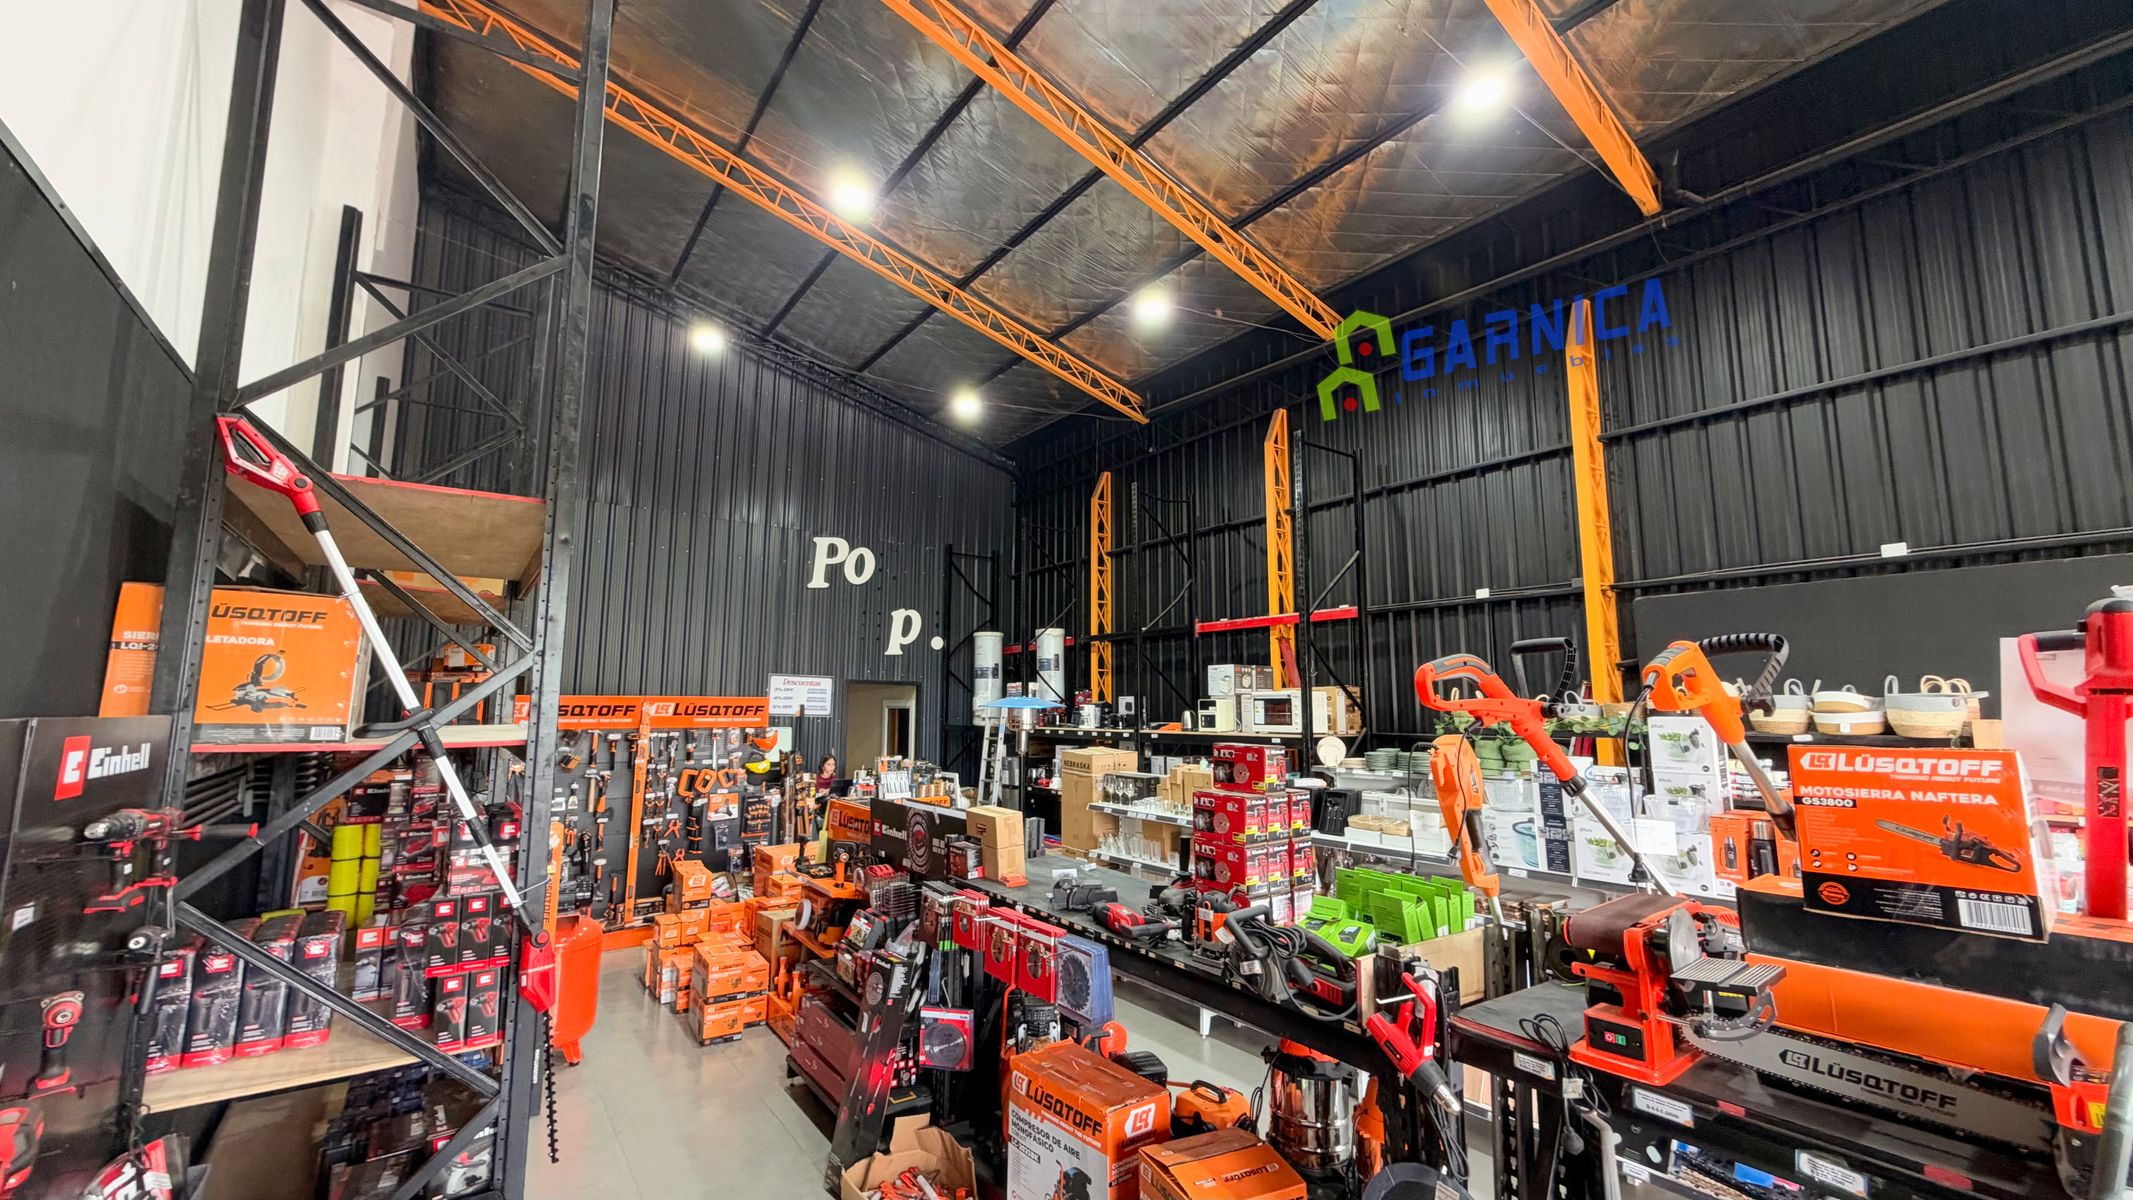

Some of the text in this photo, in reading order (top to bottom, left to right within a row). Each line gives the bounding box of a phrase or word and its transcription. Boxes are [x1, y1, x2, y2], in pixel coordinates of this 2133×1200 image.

[211, 603, 327, 624] ÜSQTOFF
[120, 642, 157, 651] LQI-2
[206, 635, 275, 647] LETADORA
[558, 704, 636, 716] SQTOFF
[672, 702, 765, 716] LÜSQTOFF
[87, 742, 151, 780] Einhell
[1063, 760, 1091, 770] NEBRASKA
[1837, 753, 2003, 777] LÜSQTOFF
[1800, 785, 1998, 805] MOTOSIERRA NAFTERA
[1801, 797, 1854, 807] GS3800
[1812, 1057, 1957, 1109] LÜSQTOFF
[1026, 1080, 1103, 1137] LÜSQTOFF
[1011, 1109, 1081, 1160] COMPRESOR DE AIRE
[1011, 1120, 1054, 1153] MONOFÁSICO
